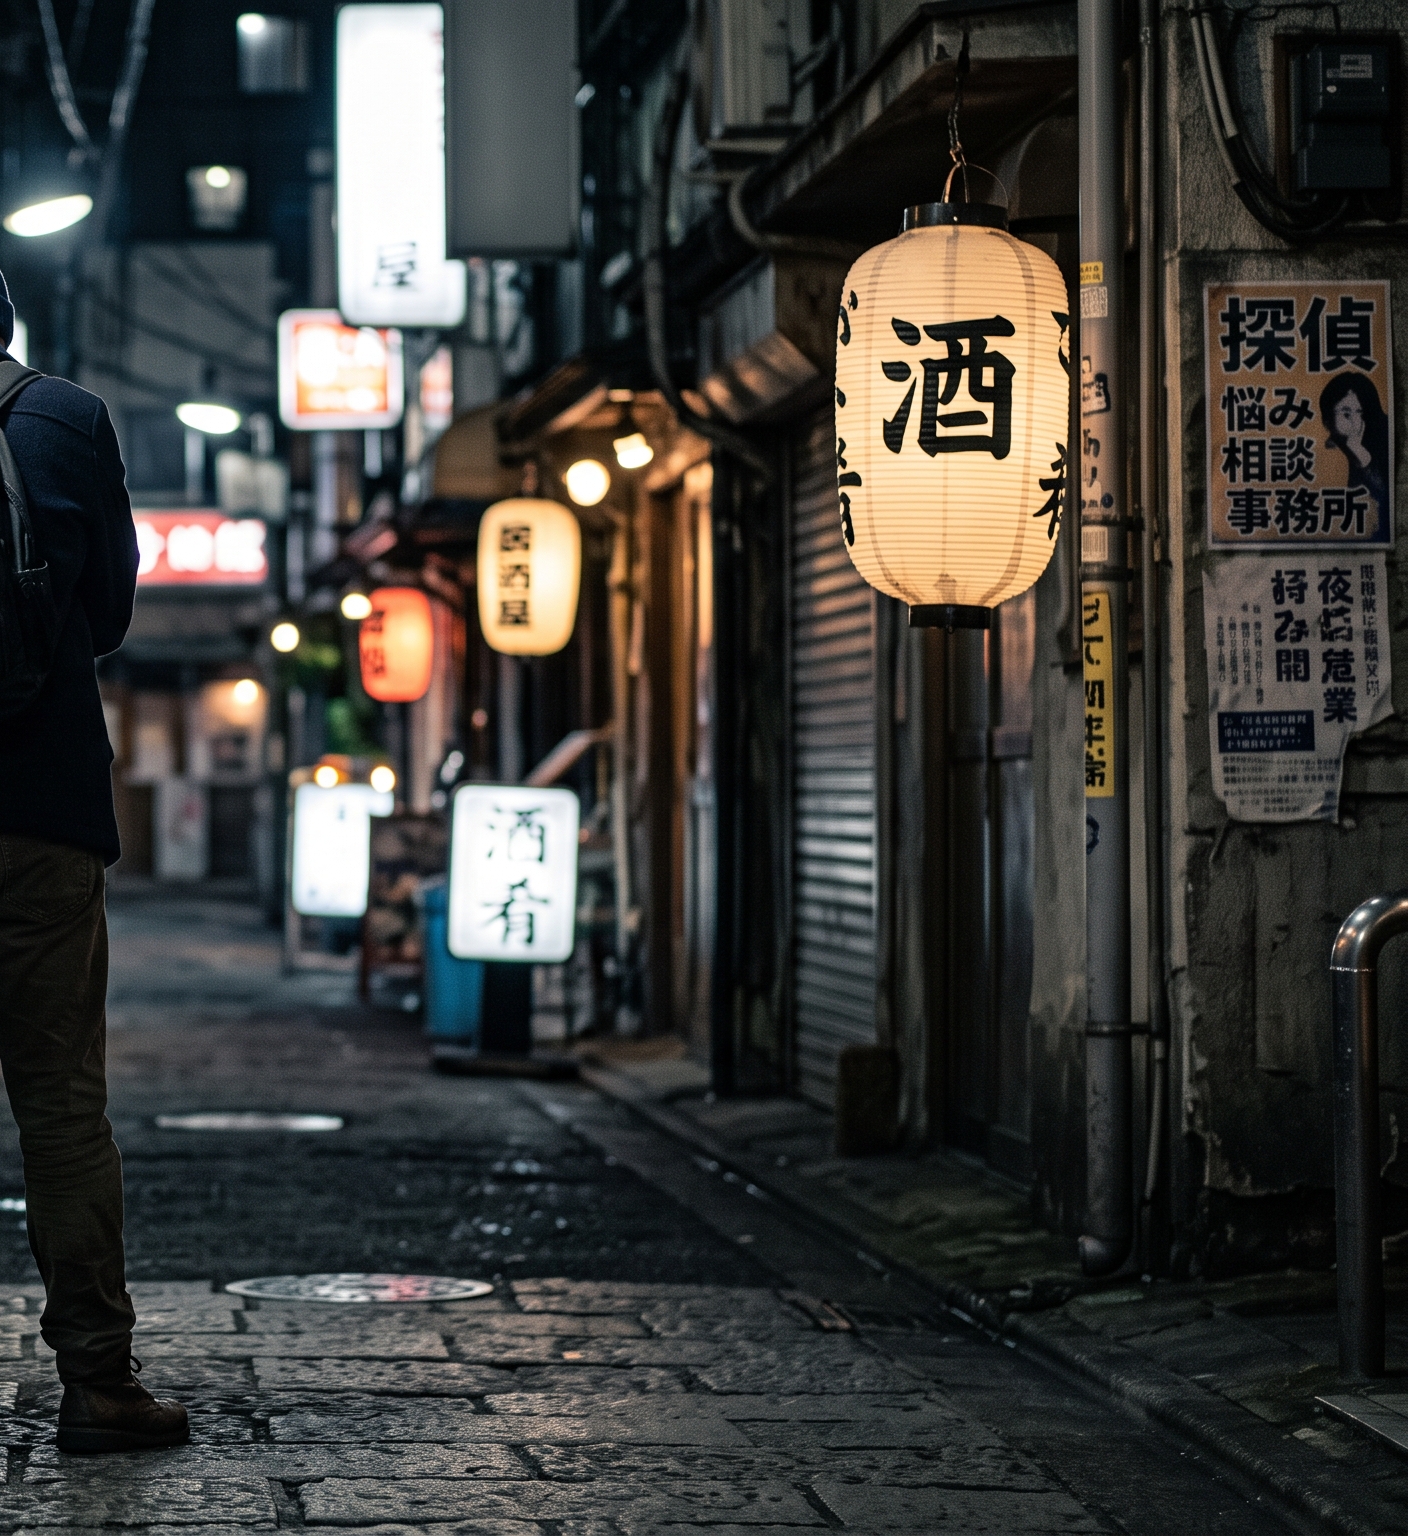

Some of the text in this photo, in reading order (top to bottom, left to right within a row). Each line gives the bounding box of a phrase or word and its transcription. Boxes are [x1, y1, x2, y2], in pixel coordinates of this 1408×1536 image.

[1220, 297, 1377, 372] 探偵
[881, 315, 1016, 460] 酒
[1221, 386, 1314, 432] 悩み
[1222, 437, 1314, 483] 相談
[1227, 488, 1368, 534] 事務所
[481, 806, 549, 944] 酒肴
